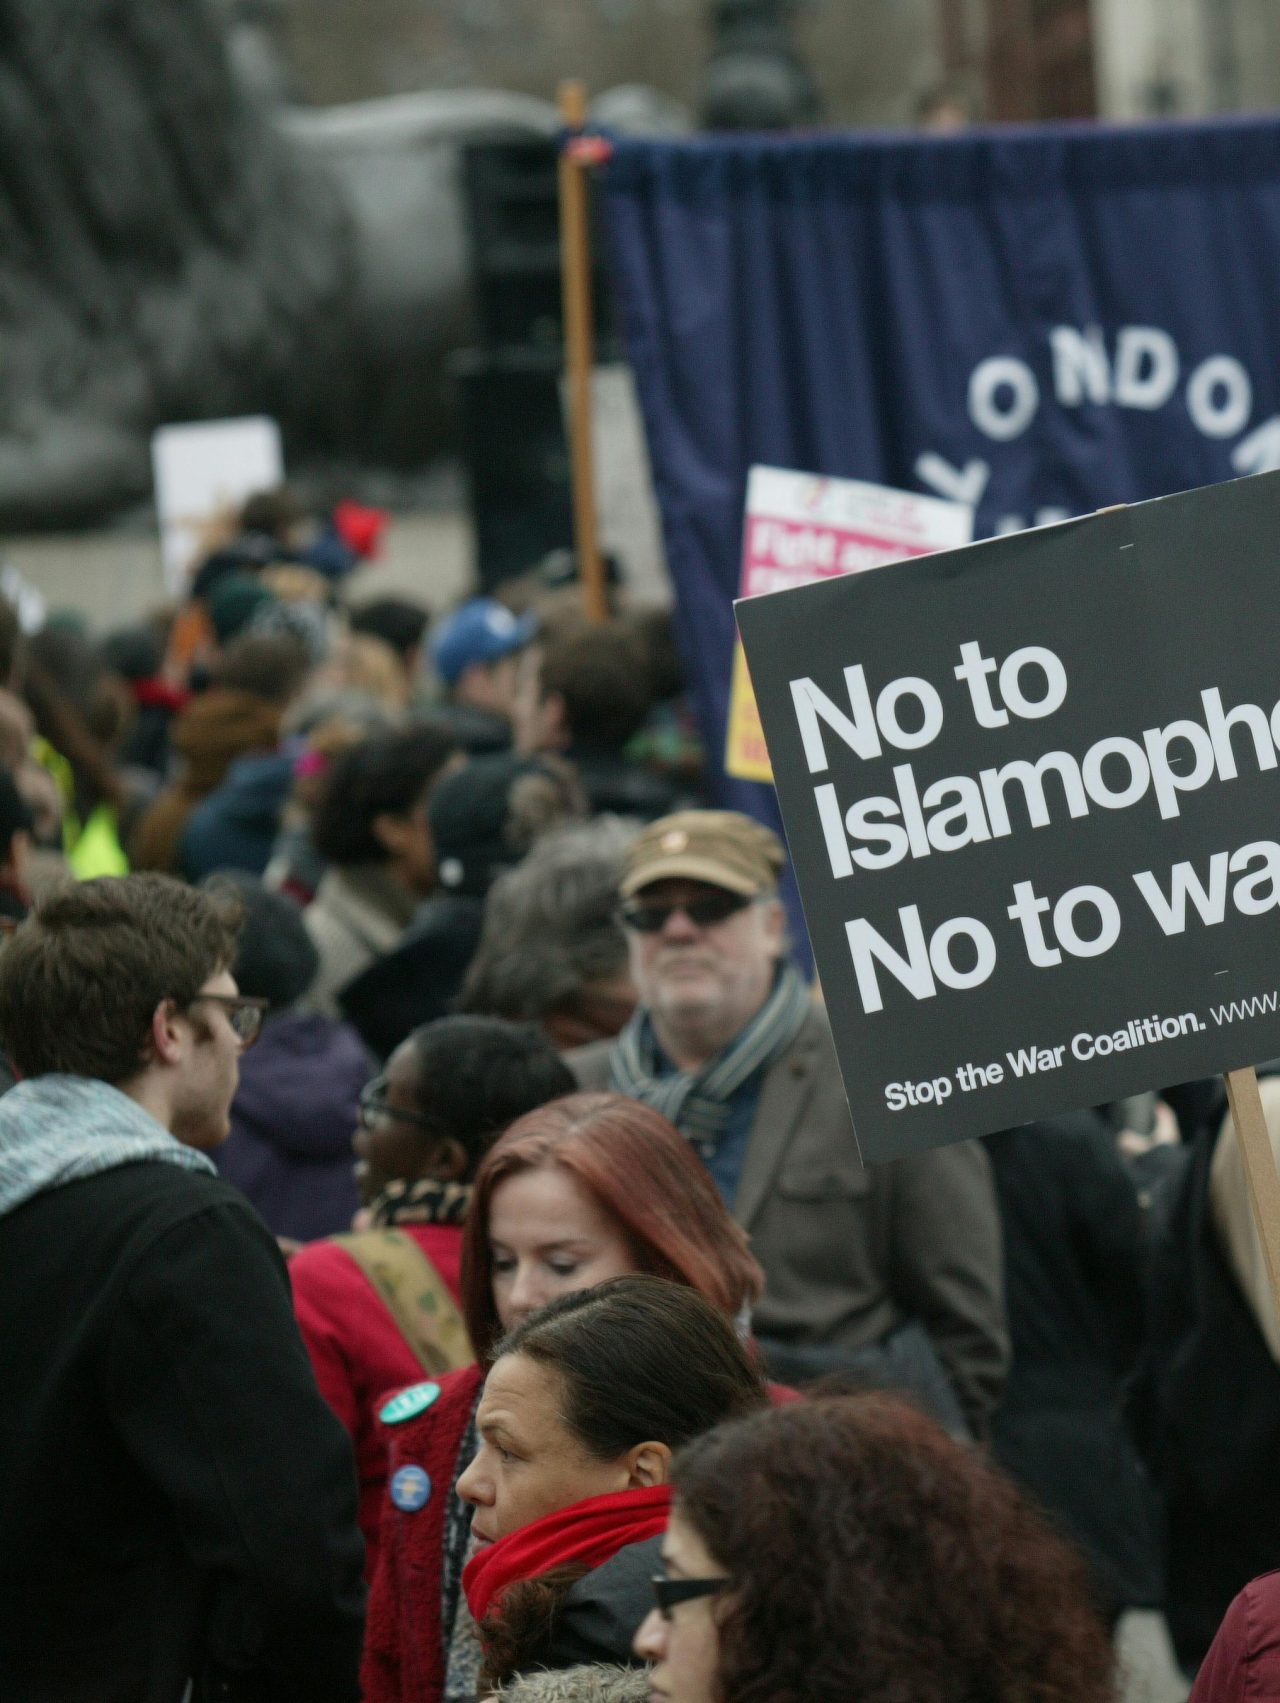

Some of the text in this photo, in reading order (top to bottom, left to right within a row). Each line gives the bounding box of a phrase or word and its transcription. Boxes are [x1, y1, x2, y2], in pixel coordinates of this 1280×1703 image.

[789, 663, 944, 774] No
[954, 640, 1068, 729] to
[844, 903, 997, 1014] No
[1007, 880, 1122, 968] to
[884, 1074, 953, 1111] Stop
[955, 1062, 1004, 1092] the
[1006, 1045, 1066, 1078] War
[1070, 1011, 1207, 1061] Coalition.
